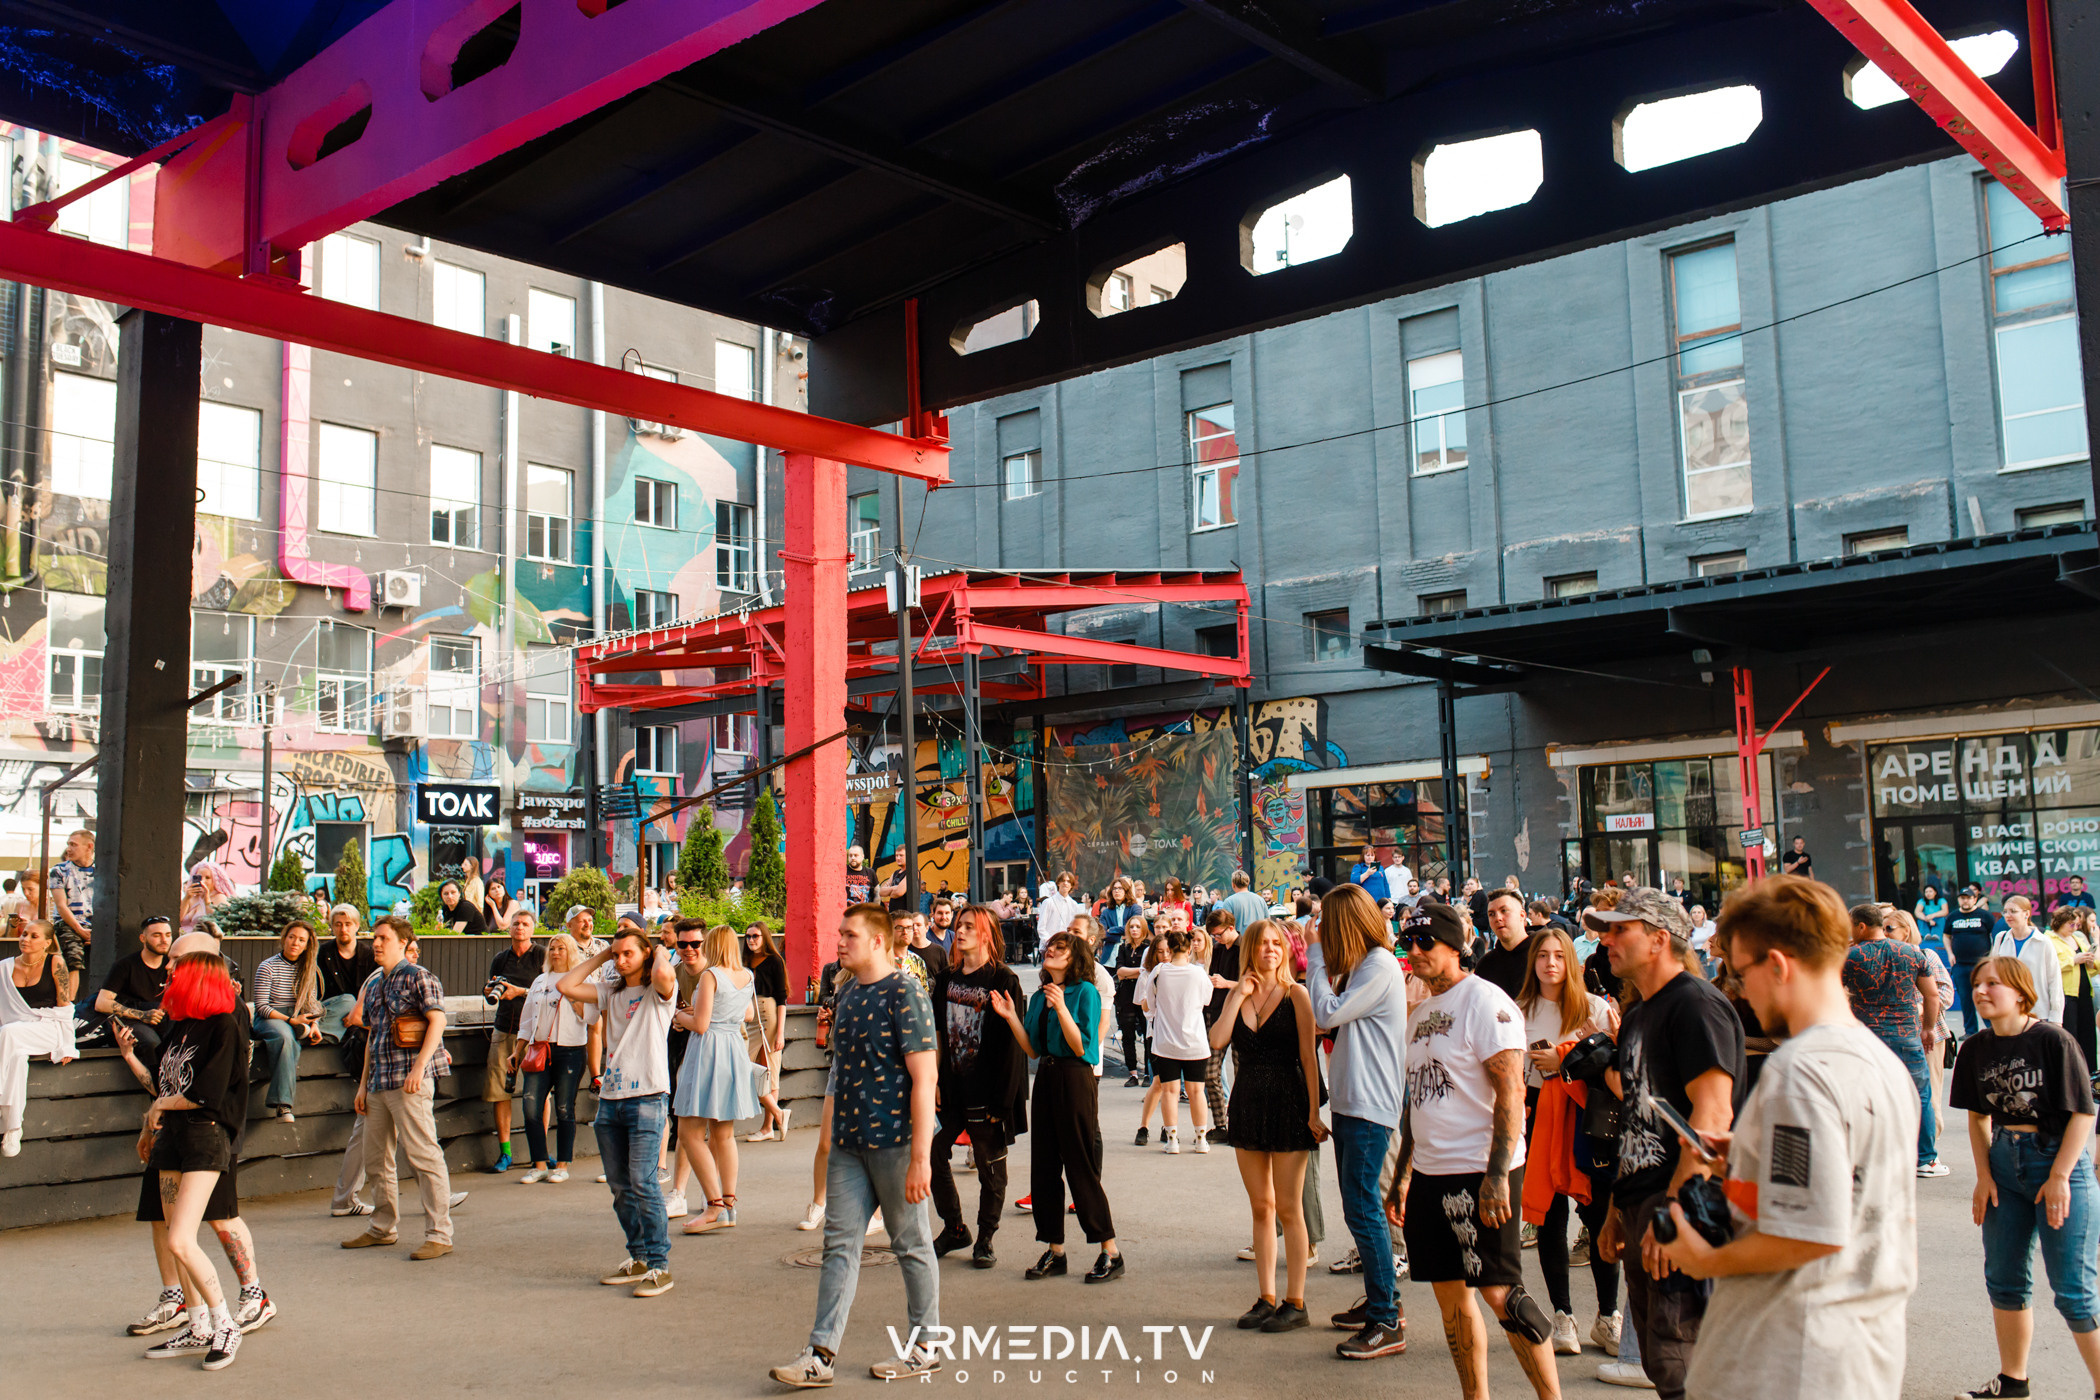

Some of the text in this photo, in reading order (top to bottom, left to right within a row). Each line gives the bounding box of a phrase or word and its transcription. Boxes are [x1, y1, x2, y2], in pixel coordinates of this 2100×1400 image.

[1880, 742, 2062, 779] АРЕНДА
[1880, 769, 2072, 805] ПОМЕЩЕНИЙ
[1615, 816, 1645, 829] КАЛЬЯН
[1971, 826, 1984, 839] В
[1981, 838, 2098, 857] МИЧЕСКОМ
[1974, 856, 2100, 876] КВАРТАЛЕ
